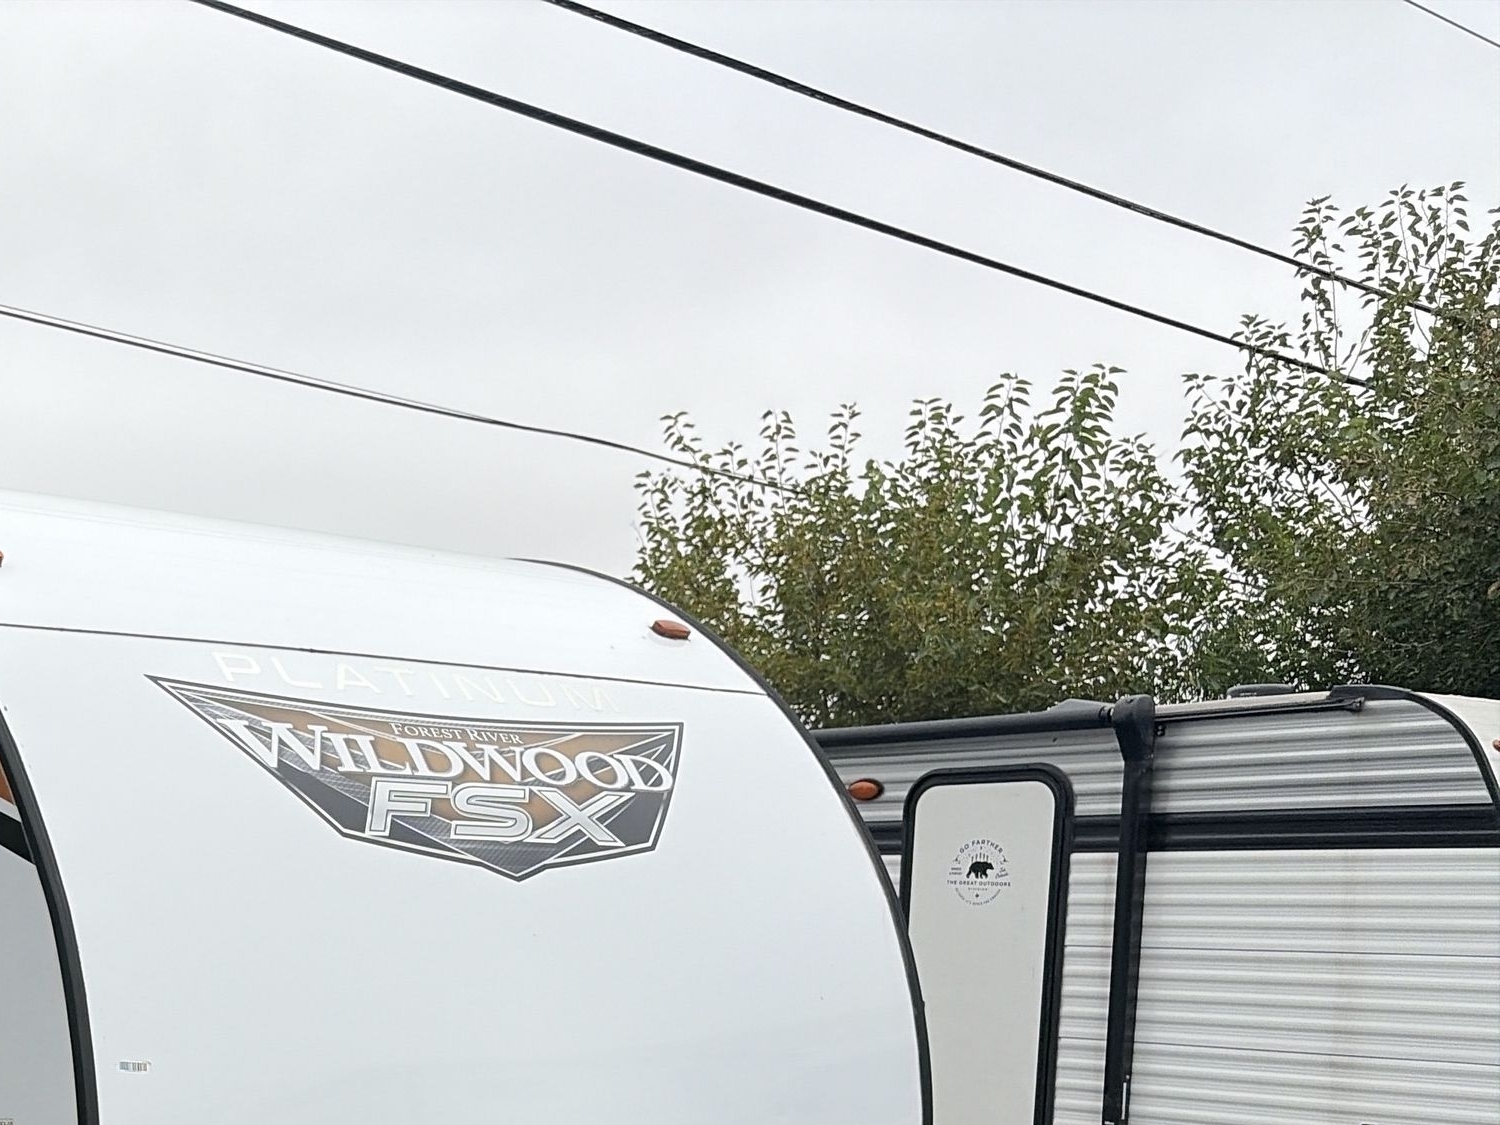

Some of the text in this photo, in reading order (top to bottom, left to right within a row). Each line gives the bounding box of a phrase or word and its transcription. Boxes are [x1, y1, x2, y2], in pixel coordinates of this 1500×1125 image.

[211, 651, 620, 713] PLATINUM
[216, 717, 673, 792] WILDWOOD
[389, 722, 524, 745] FOREST RIVER
[365, 775, 628, 847] FSX
[971, 839, 1004, 854] FARTHER
